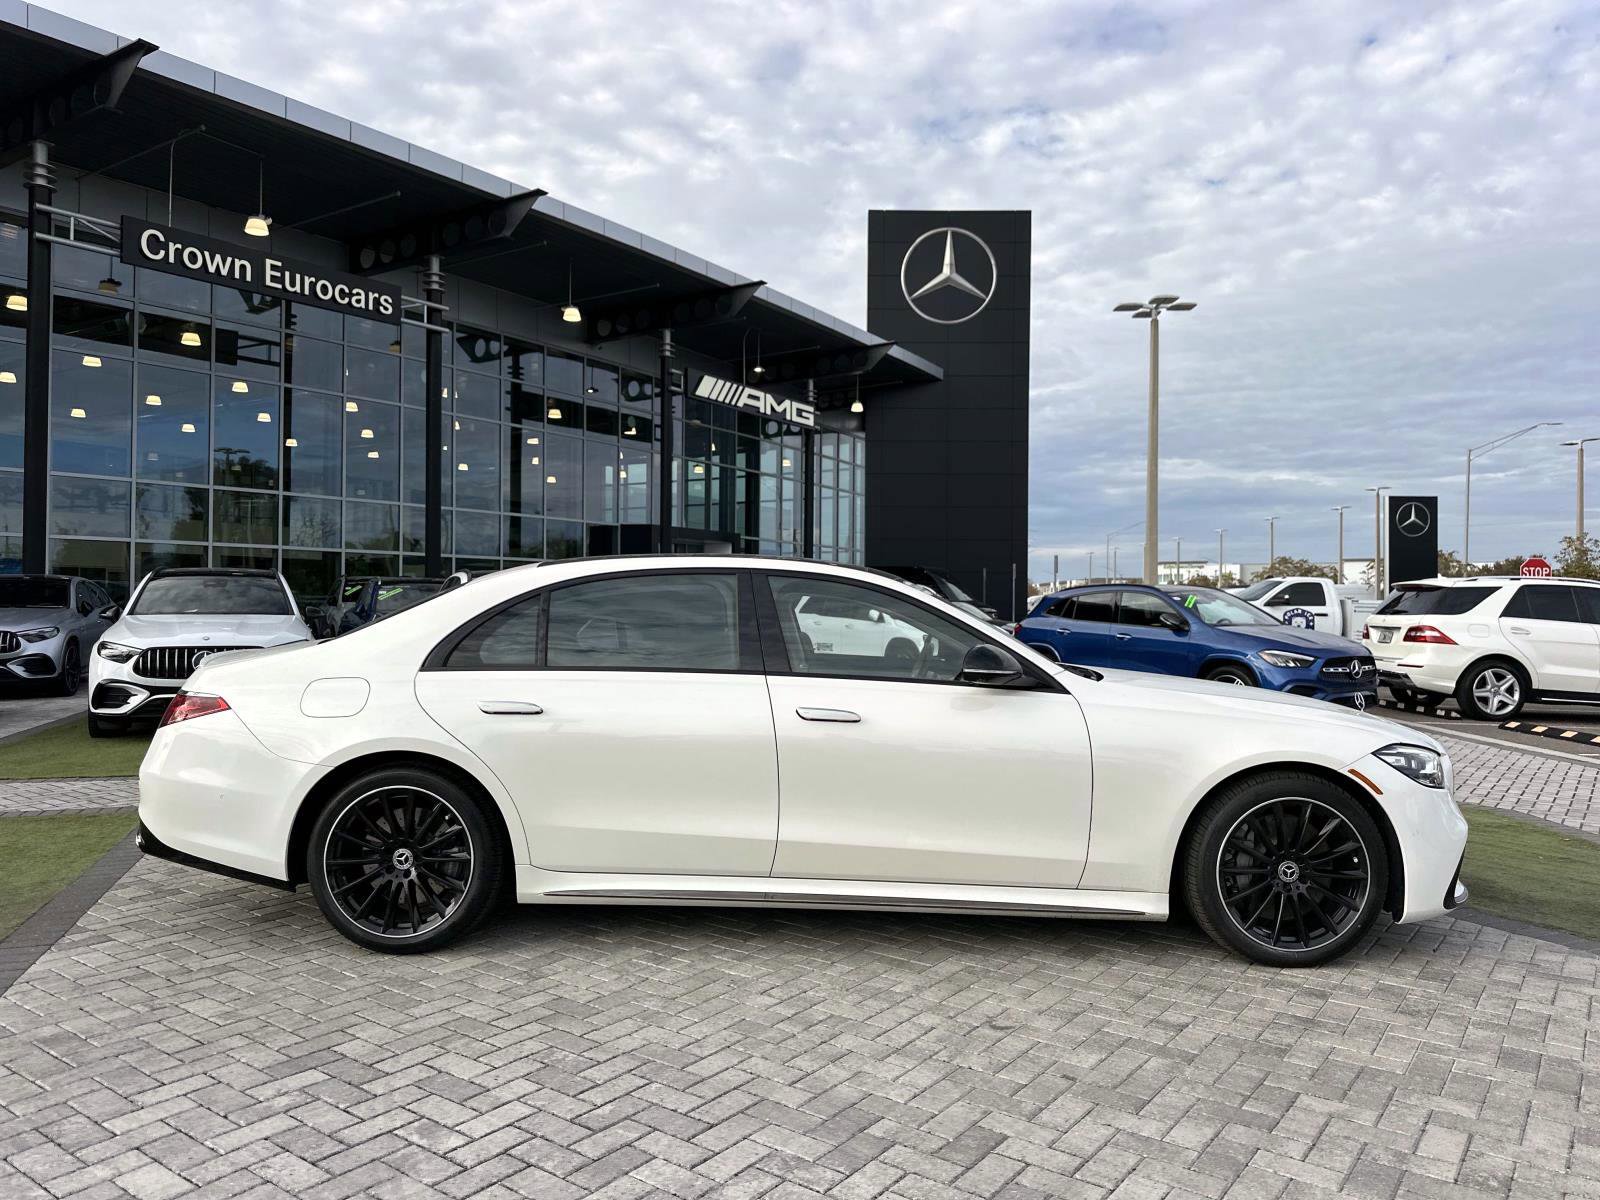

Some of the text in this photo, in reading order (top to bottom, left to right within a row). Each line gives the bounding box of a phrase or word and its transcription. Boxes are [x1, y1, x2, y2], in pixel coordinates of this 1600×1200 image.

[140, 229, 393, 315] Crown Eurocars
[735, 386, 815, 427] AMG
[1522, 566, 1550, 577] STOP
